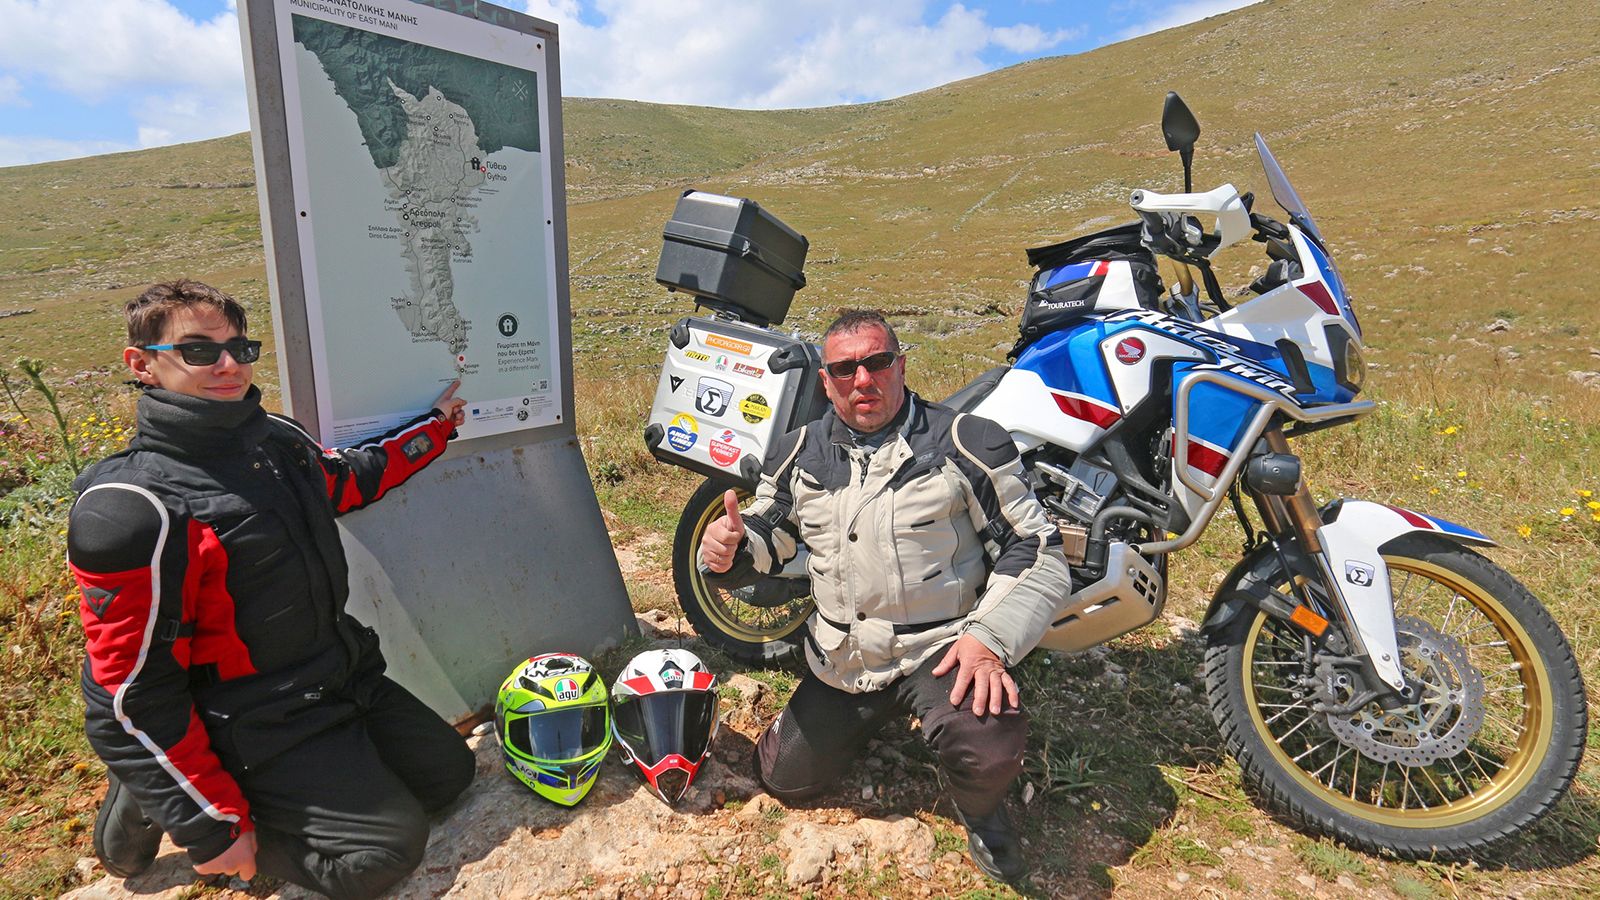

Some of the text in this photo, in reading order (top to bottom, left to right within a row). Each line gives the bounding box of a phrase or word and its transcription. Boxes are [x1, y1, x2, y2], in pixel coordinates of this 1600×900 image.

[290, 0, 398, 30] MUNICIPALITY OF EAST MANI
[387, 10, 419, 26] ΜΑΝΗΣ
[487, 172, 507, 182] Gythio
[1048, 299, 1085, 310] TOURATECH
[711, 441, 740, 454] SUPERFAST
[558, 690, 578, 701] agv
